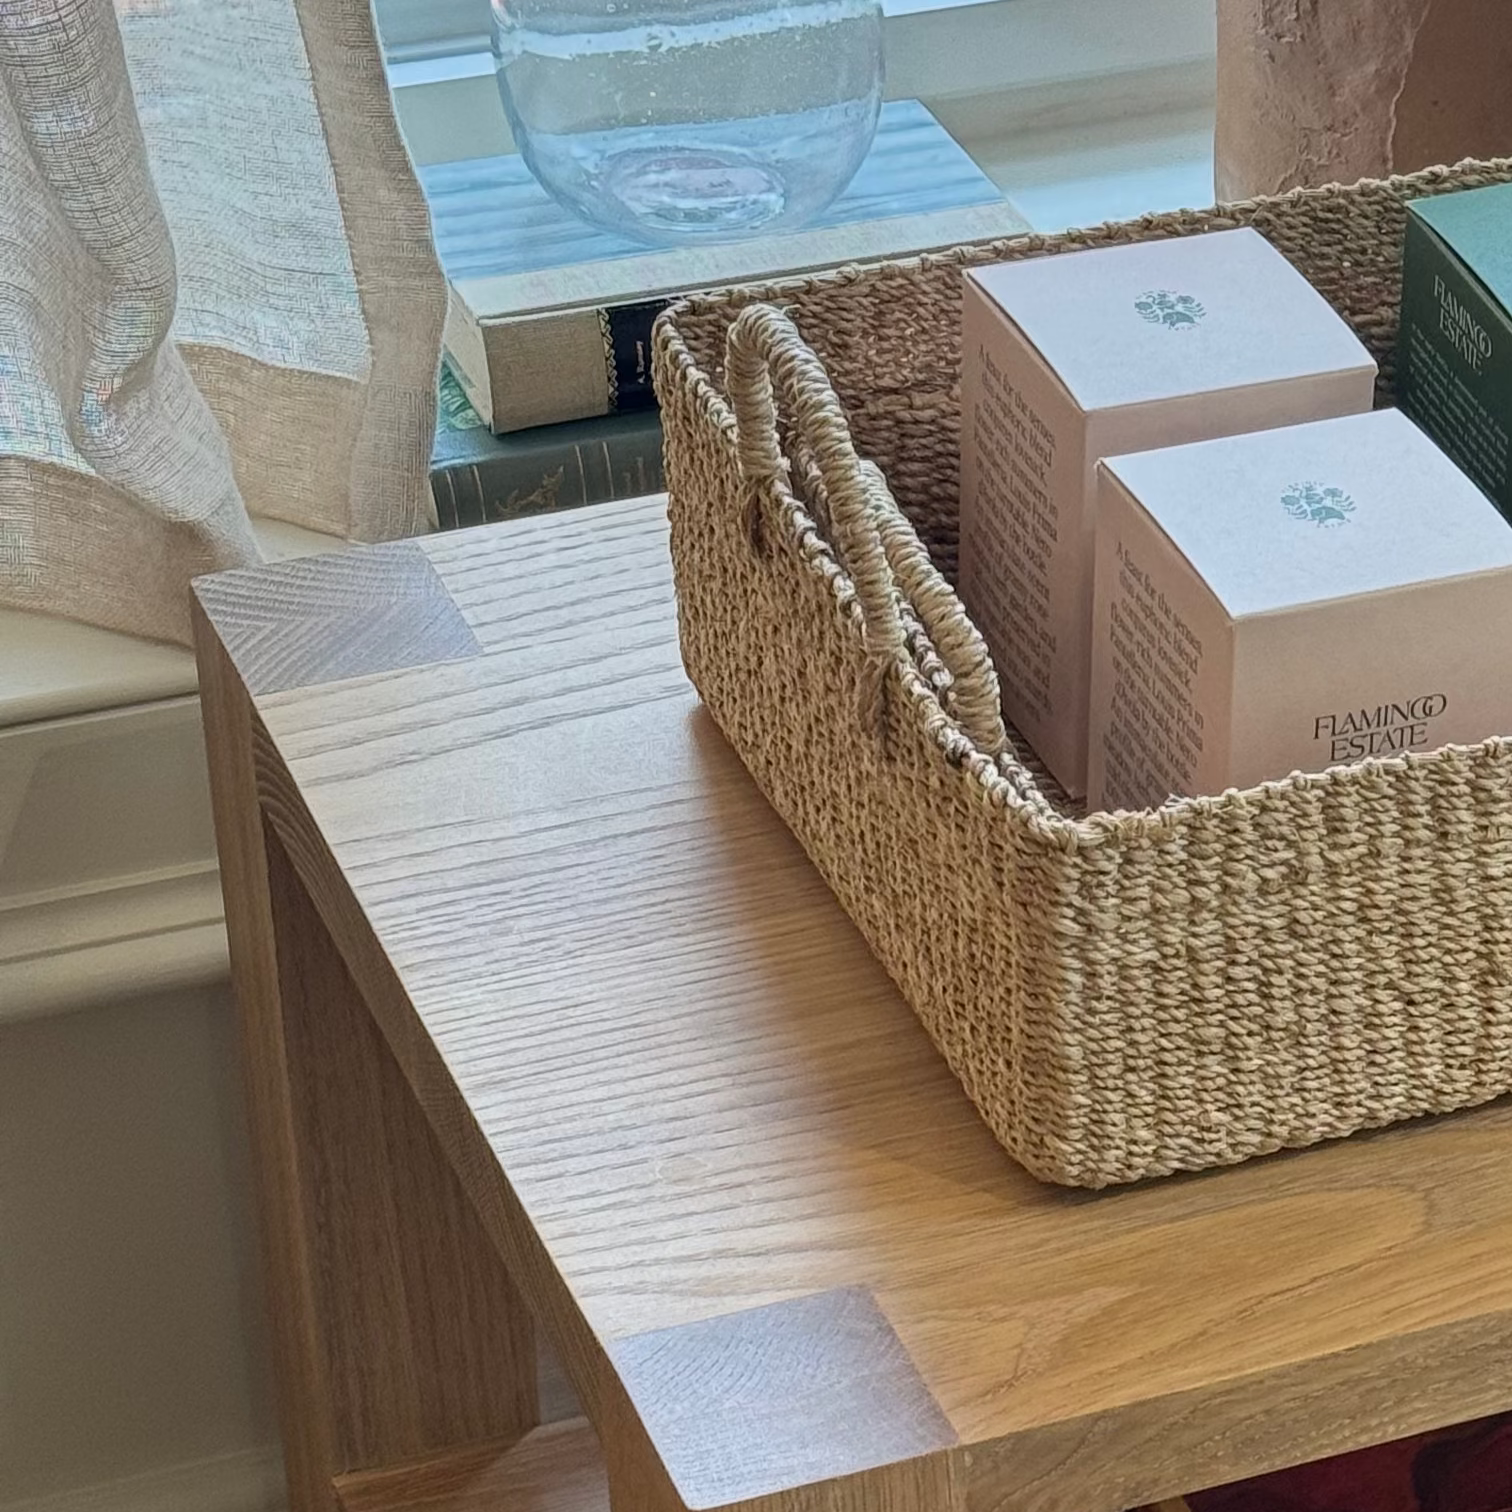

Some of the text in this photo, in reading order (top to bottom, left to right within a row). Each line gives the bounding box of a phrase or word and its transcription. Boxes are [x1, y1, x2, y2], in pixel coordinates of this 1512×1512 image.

[1434, 275, 1492, 358] FLAMINGO
[1440, 307, 1482, 375] ESTATE
[1015, 390, 1028, 418] the
[1029, 427, 1052, 468] blend
[1144, 573, 1156, 602] for
[1158, 592, 1171, 620] the
[1173, 629, 1198, 675] blend
[1313, 693, 1447, 740] FLAMINGO
[1330, 722, 1428, 762] ESTATE
